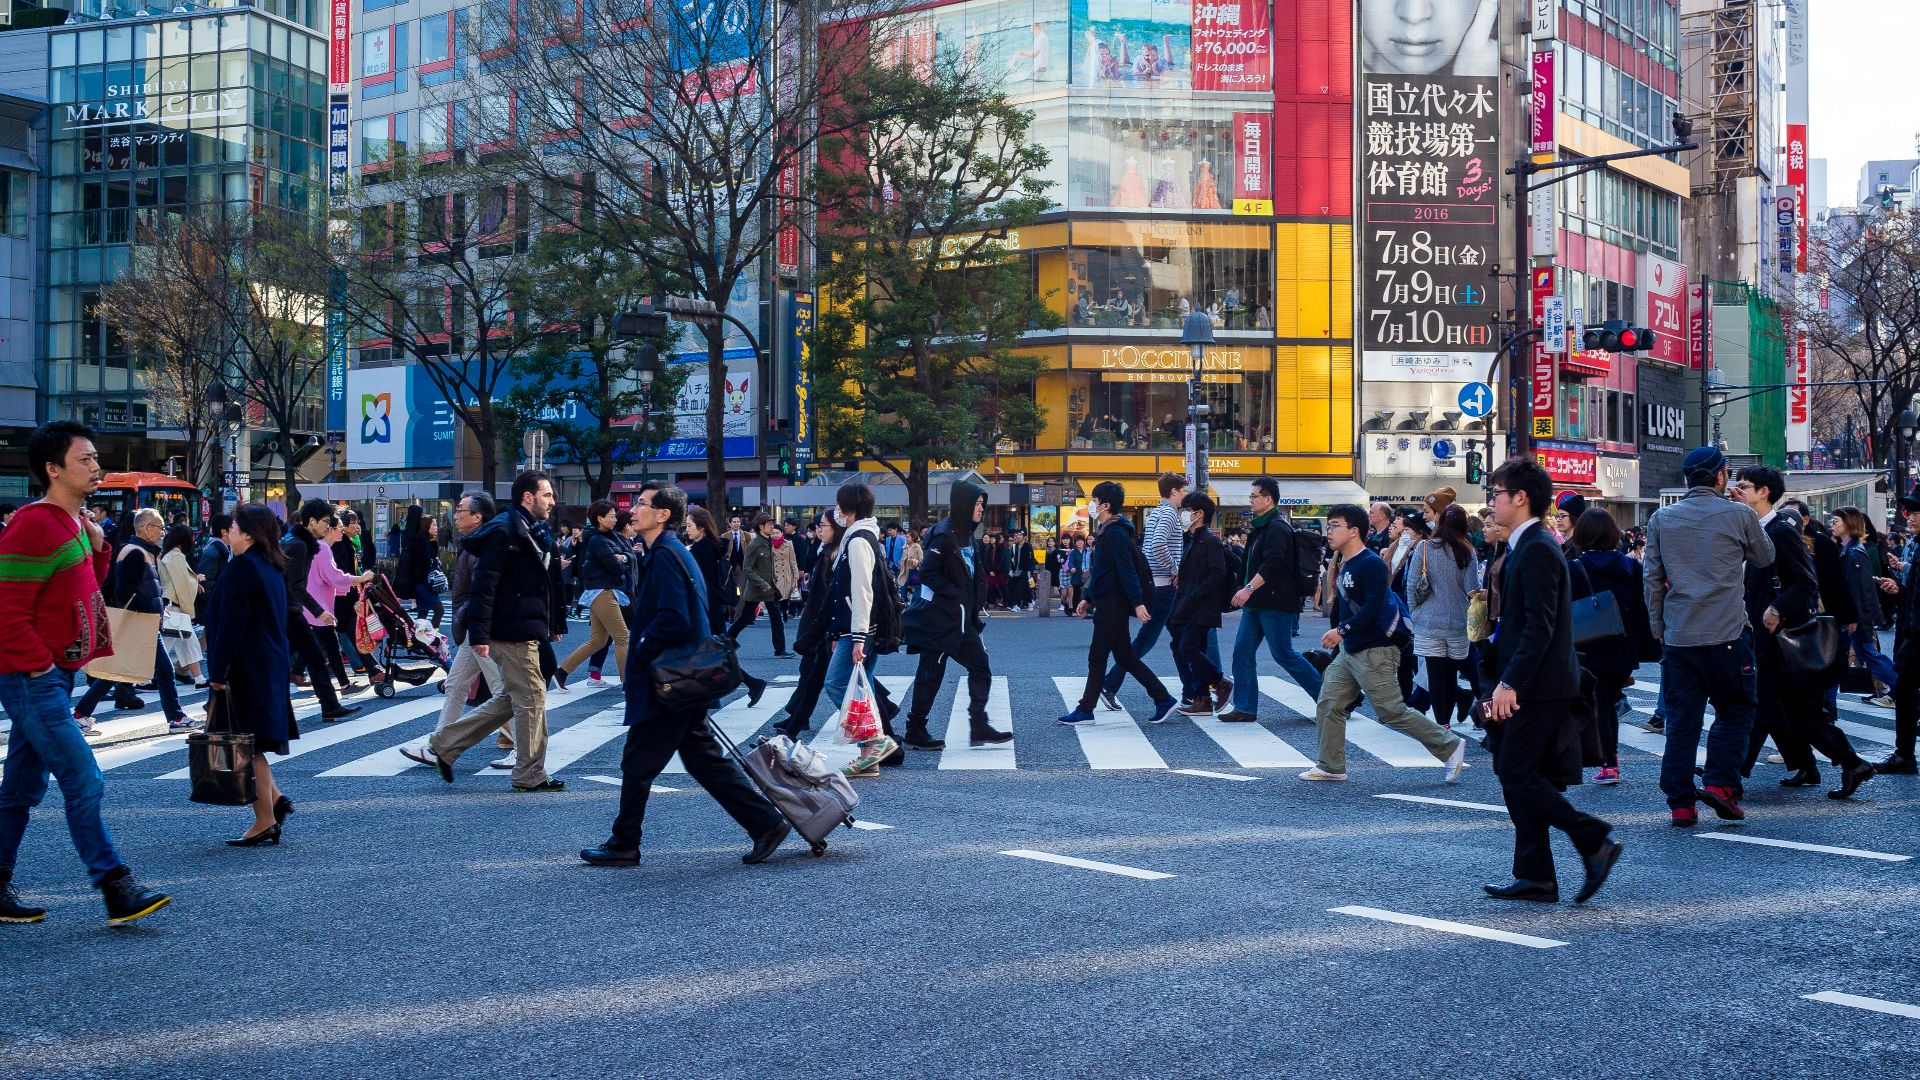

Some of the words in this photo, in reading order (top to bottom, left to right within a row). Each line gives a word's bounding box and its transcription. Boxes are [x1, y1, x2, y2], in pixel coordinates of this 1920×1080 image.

[1193, 3, 1240, 26] 沖縄
[1193, 28, 1266, 39] フォトウェディング
[1196, 63, 1244, 72] ドレスのまま
[1534, 52, 1553, 64] 5F
[107, 80, 189, 97] SHIBUYA
[334, 84, 346, 92] 7F
[1367, 82, 1495, 118] 国立代々木
[66, 101, 151, 123] MARK
[166, 93, 238, 114] CITY
[134, 132, 185, 147] マークシティ
[1366, 121, 1496, 157] 競技場第一
[1243, 121, 1262, 192] 毎日開催
[1789, 140, 1804, 170] 免税
[1367, 160, 1449, 197] 体育館
[1463, 158, 1483, 184] 3
[1457, 175, 1492, 202] Days!
[1415, 207, 1449, 220] 2016
[1375, 230, 1486, 266] 7月8日(金)
[1375, 269, 1486, 305] 7月9日(土)
[1371, 309, 1492, 345] 7月10日(日)
[1553, 300, 1563, 348] 渋谷駅前
[1654, 299, 1680, 331] アコム
[1663, 339, 1672, 357] 3F
[1127, 373, 1143, 381] EN
[1151, 374, 1217, 383] PROVECE
[91, 411, 119, 421] MRK
[121, 414, 144, 423] CTY
[1535, 418, 1552, 436] 薬
[1647, 403, 1686, 440] LUSH
